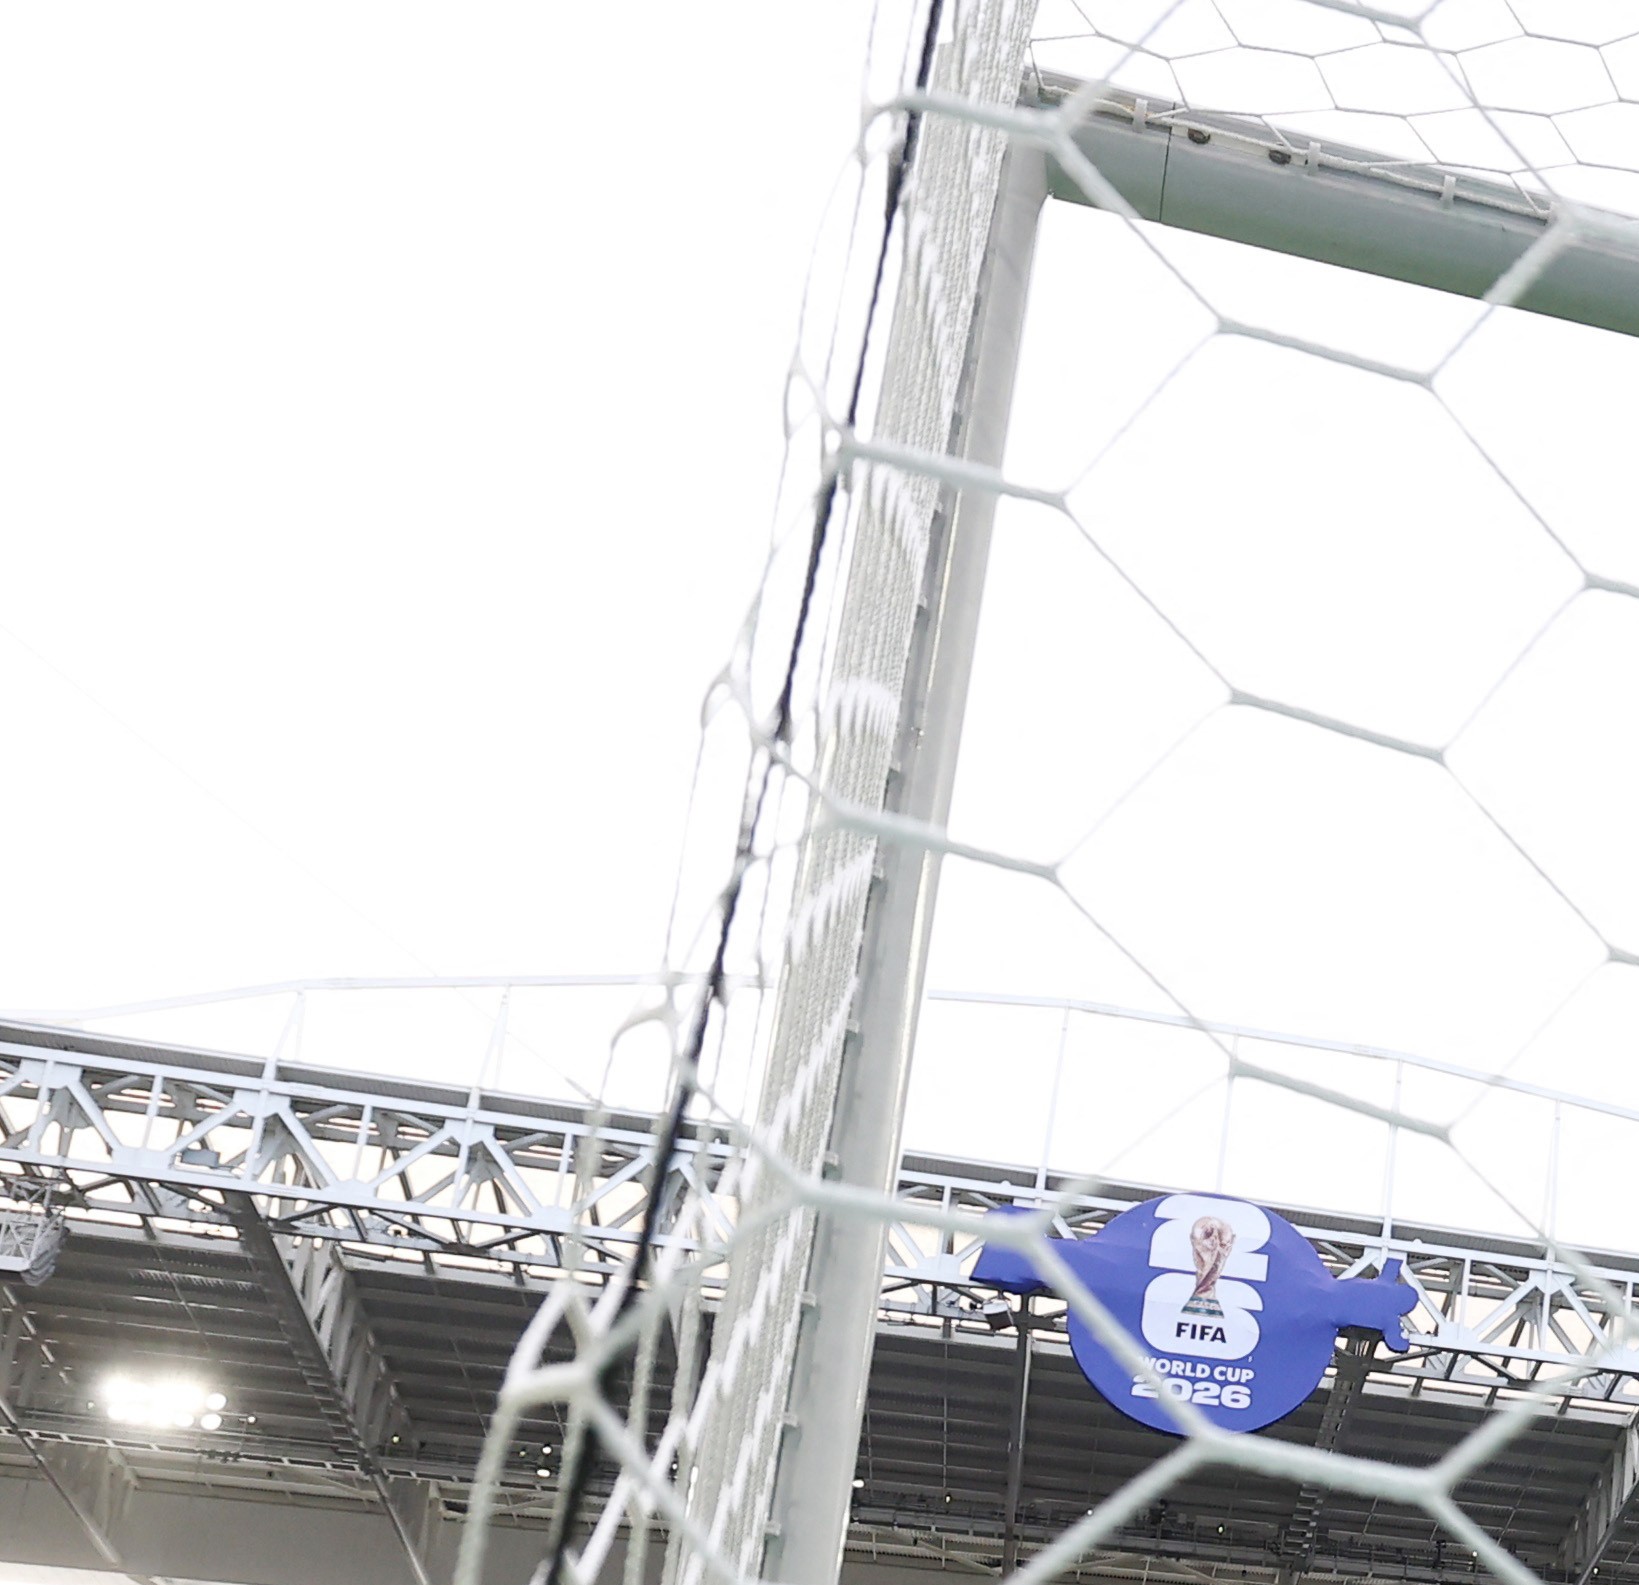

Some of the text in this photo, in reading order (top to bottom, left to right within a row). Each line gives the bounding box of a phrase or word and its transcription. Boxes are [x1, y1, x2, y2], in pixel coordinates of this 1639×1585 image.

[1175, 1321, 1227, 1344] FIFA
[1139, 1356, 1255, 1384] WORLD CUP
[1130, 1375, 1252, 1410] 2026
